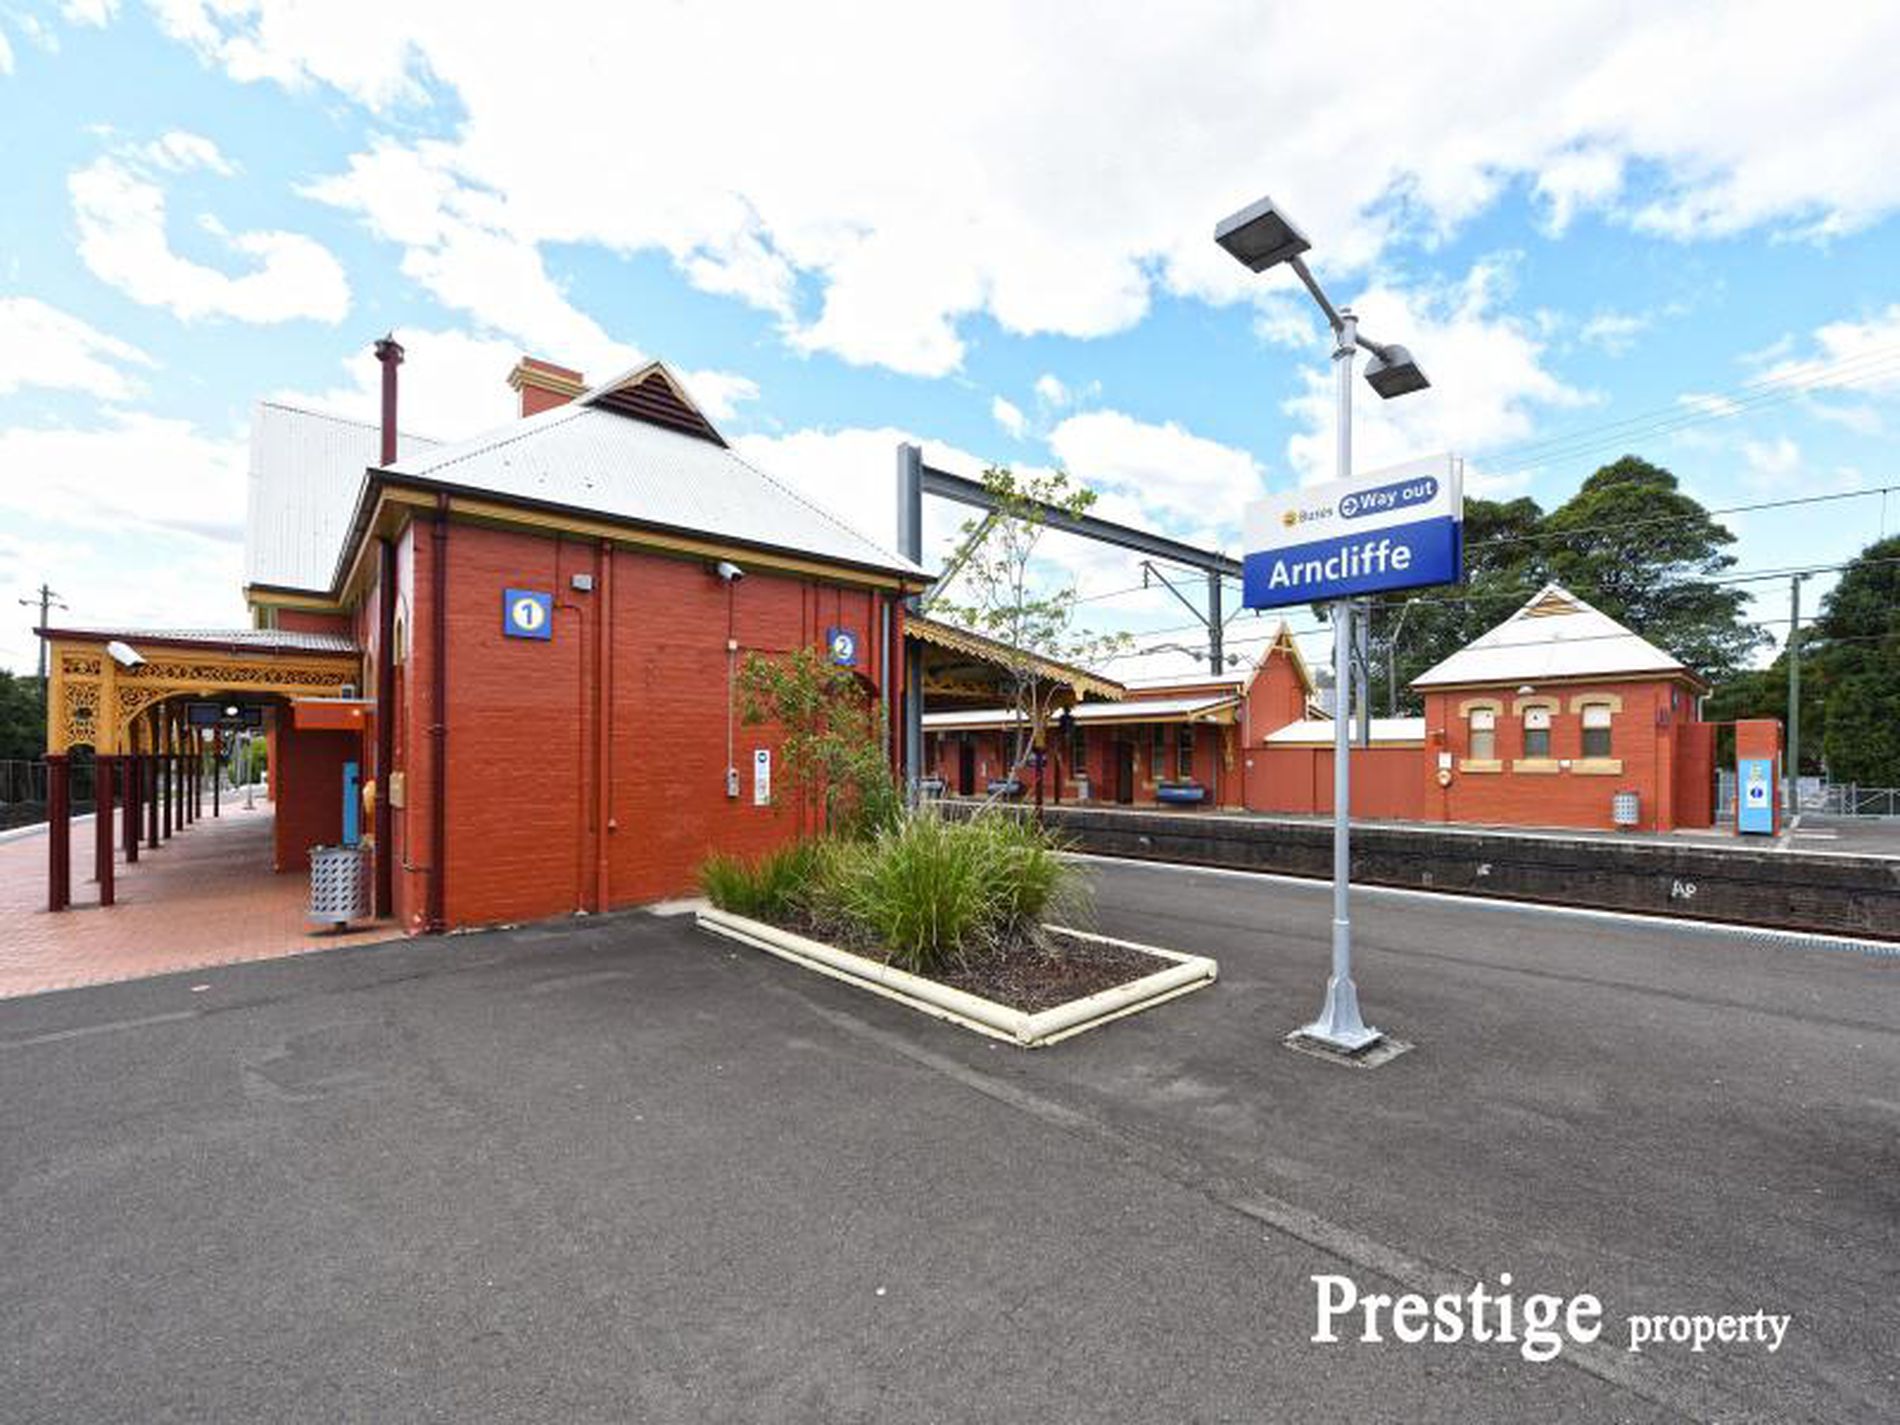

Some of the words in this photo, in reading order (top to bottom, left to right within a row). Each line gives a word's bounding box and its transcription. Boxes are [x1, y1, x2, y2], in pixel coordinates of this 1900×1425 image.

[1360, 490, 1398, 509] Way
[1402, 481, 1433, 500] out
[1268, 538, 1412, 590] Arncliffe
[521, 603, 533, 625] 1
